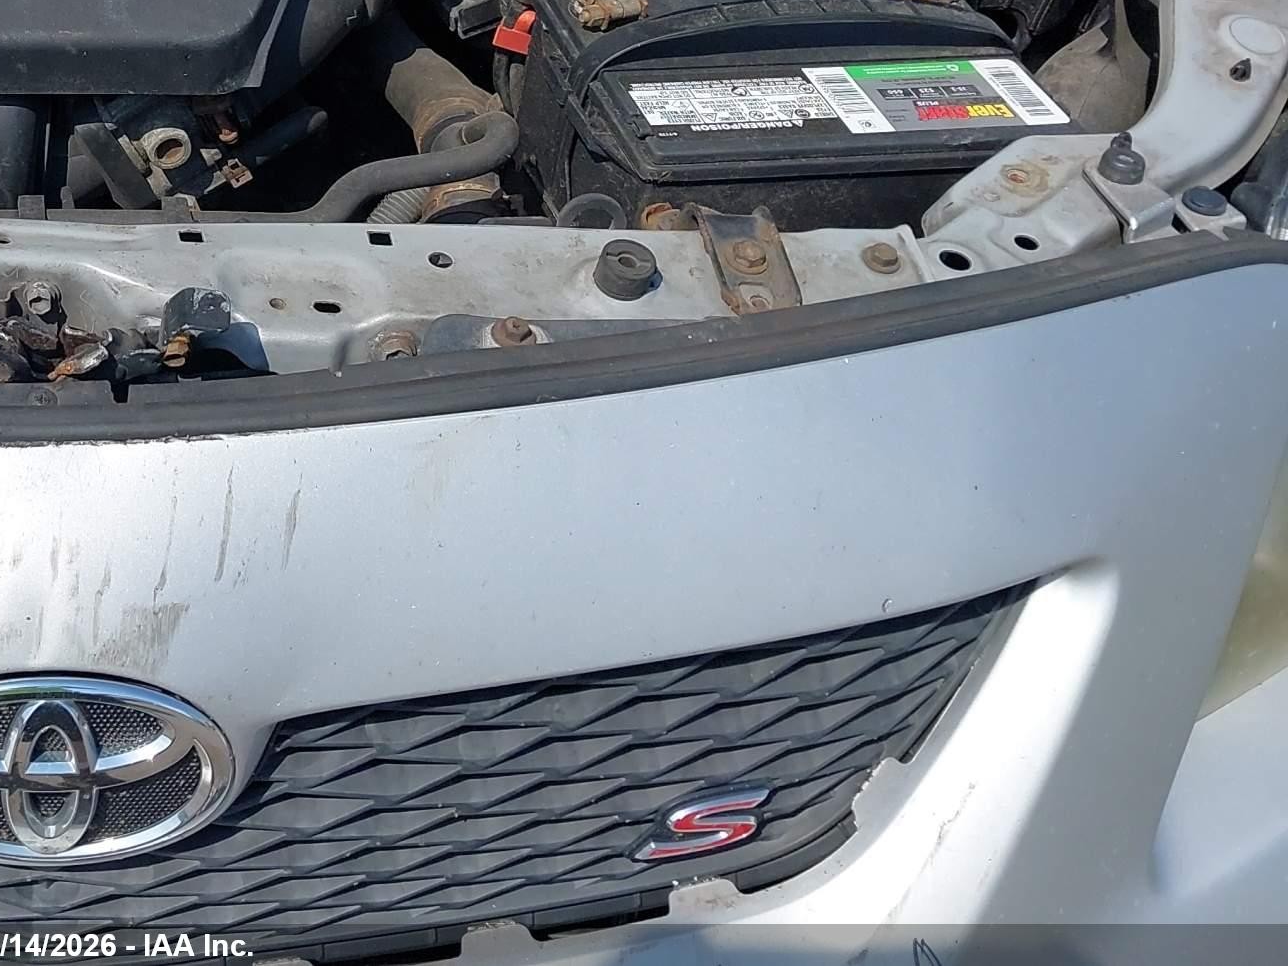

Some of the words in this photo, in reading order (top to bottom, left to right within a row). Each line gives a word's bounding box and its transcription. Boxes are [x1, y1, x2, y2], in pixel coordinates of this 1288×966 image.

[915, 104, 1015, 121] EverStart
[690, 120, 793, 132] DANGER/POISON
[634, 789, 770, 860] S
